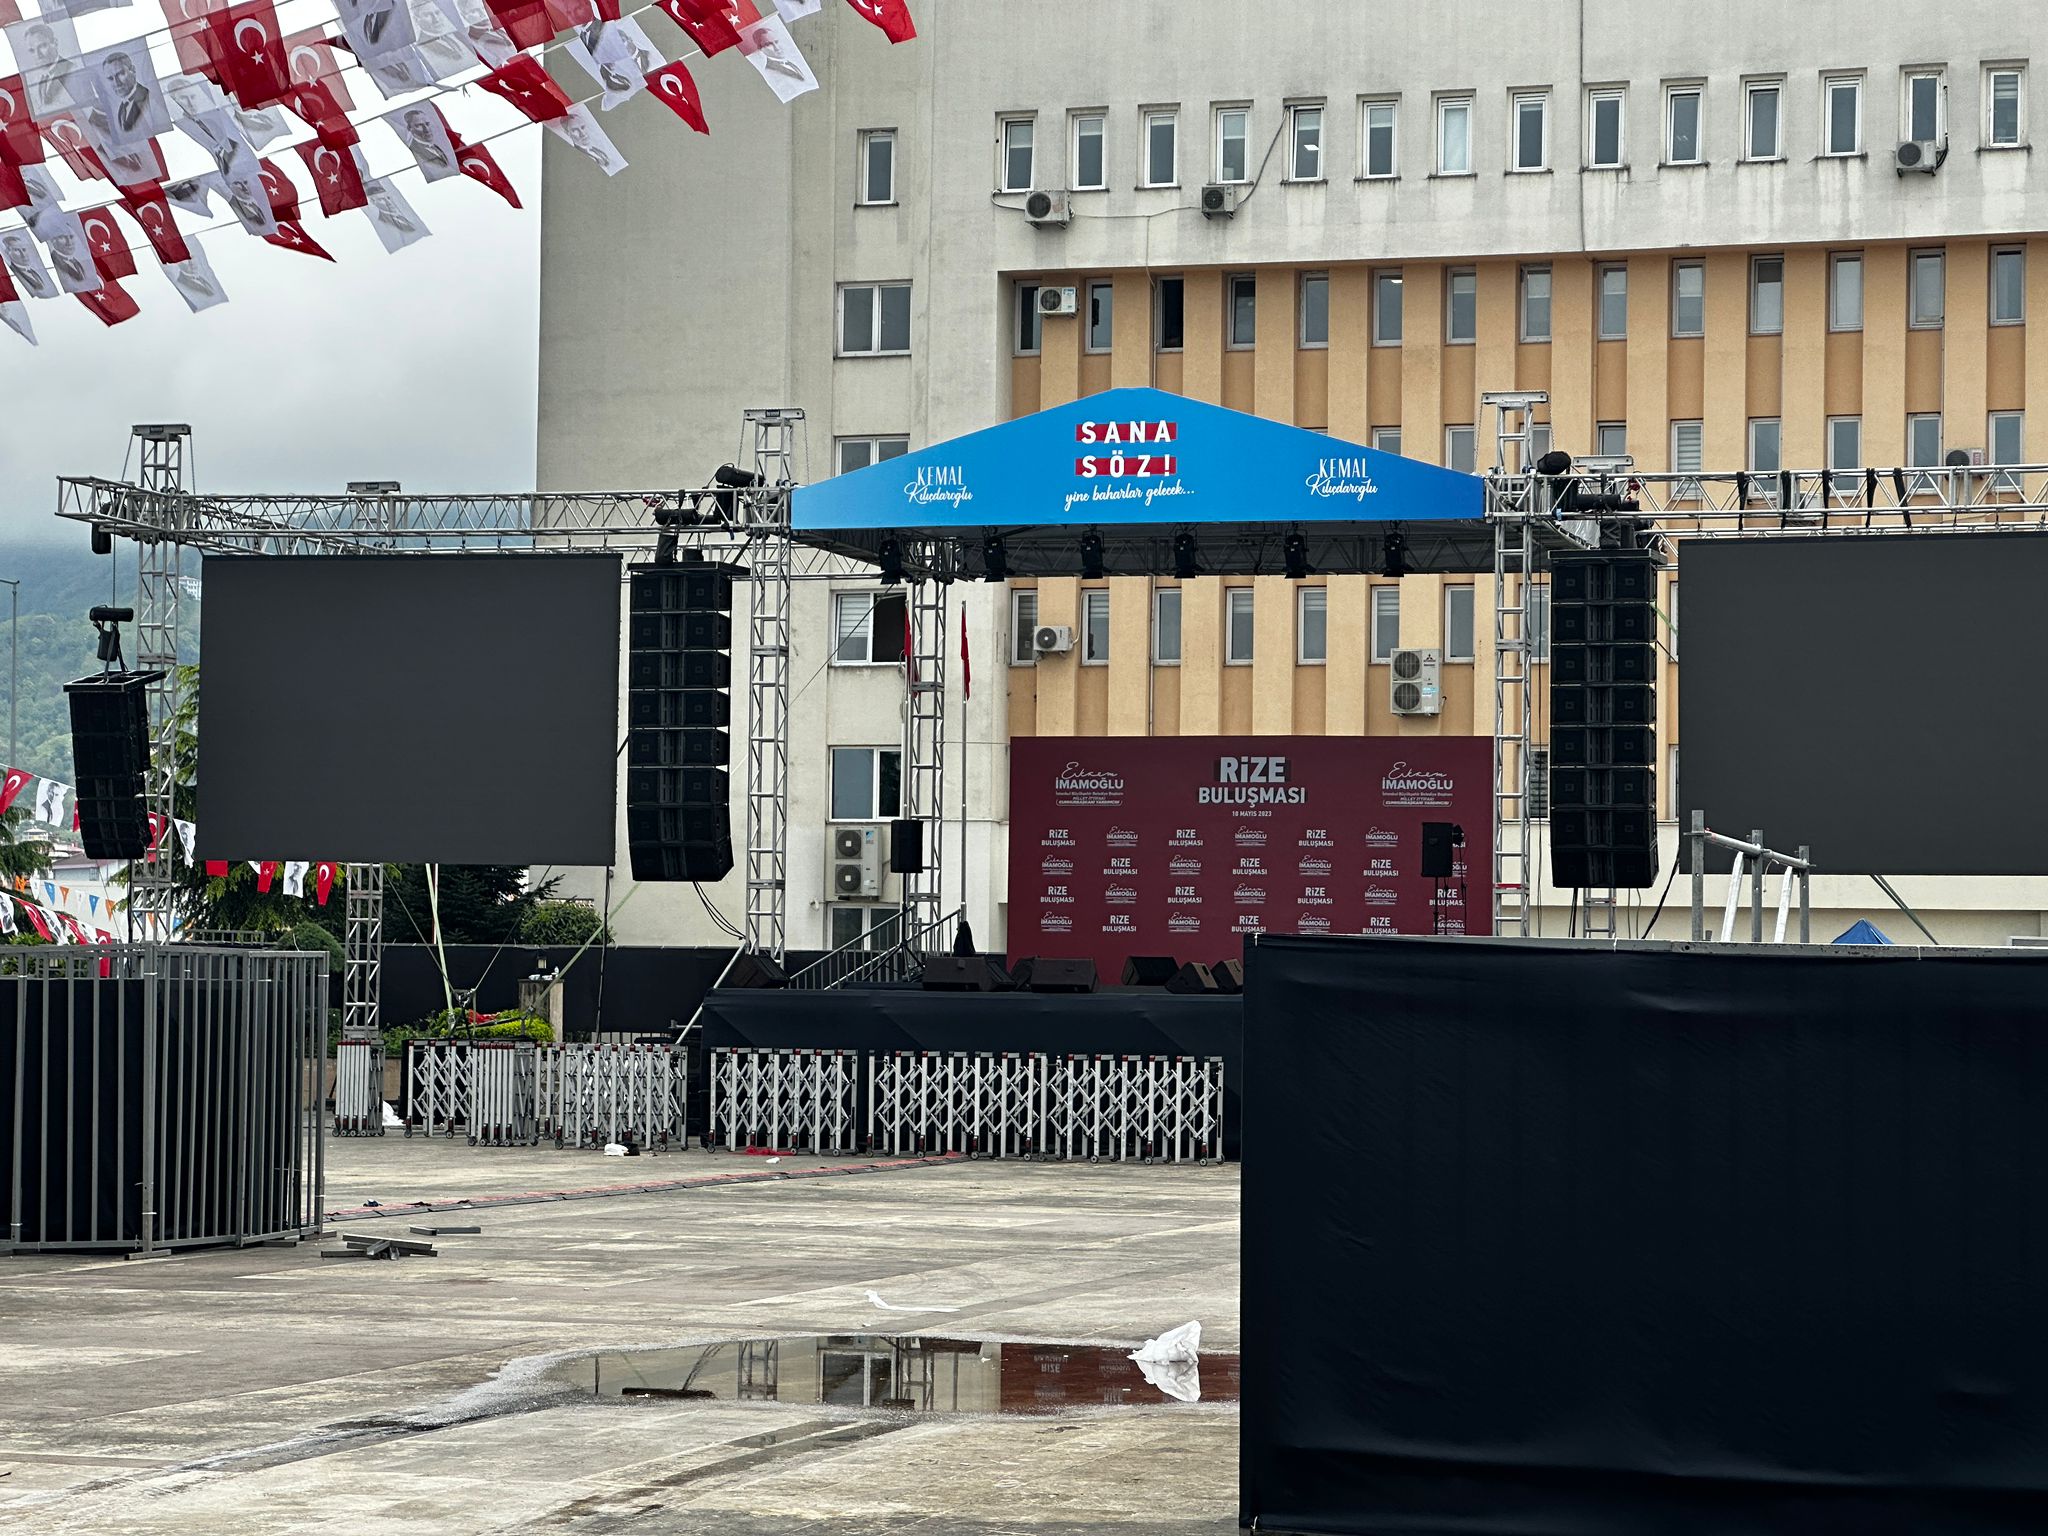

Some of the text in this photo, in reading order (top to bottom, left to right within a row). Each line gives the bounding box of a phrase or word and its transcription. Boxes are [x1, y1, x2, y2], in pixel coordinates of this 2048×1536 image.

[1081, 420, 1171, 444] SANA
[1082, 450, 1170, 478] SÖZ!
[1319, 458, 1369, 479] KEMAL
[917, 465, 964, 486] KEMAL
[1064, 479, 1195, 512] yine baharlar gelecek...
[1055, 777, 1124, 790] İMAMOĞLU
[1382, 777, 1454, 790] İMAMOĞLU
[1198, 786, 1306, 809] BULUŞMASI
[1364, 870, 1399, 878] BULUŞMASI
[1168, 897, 1203, 905] BULUŞMASI
